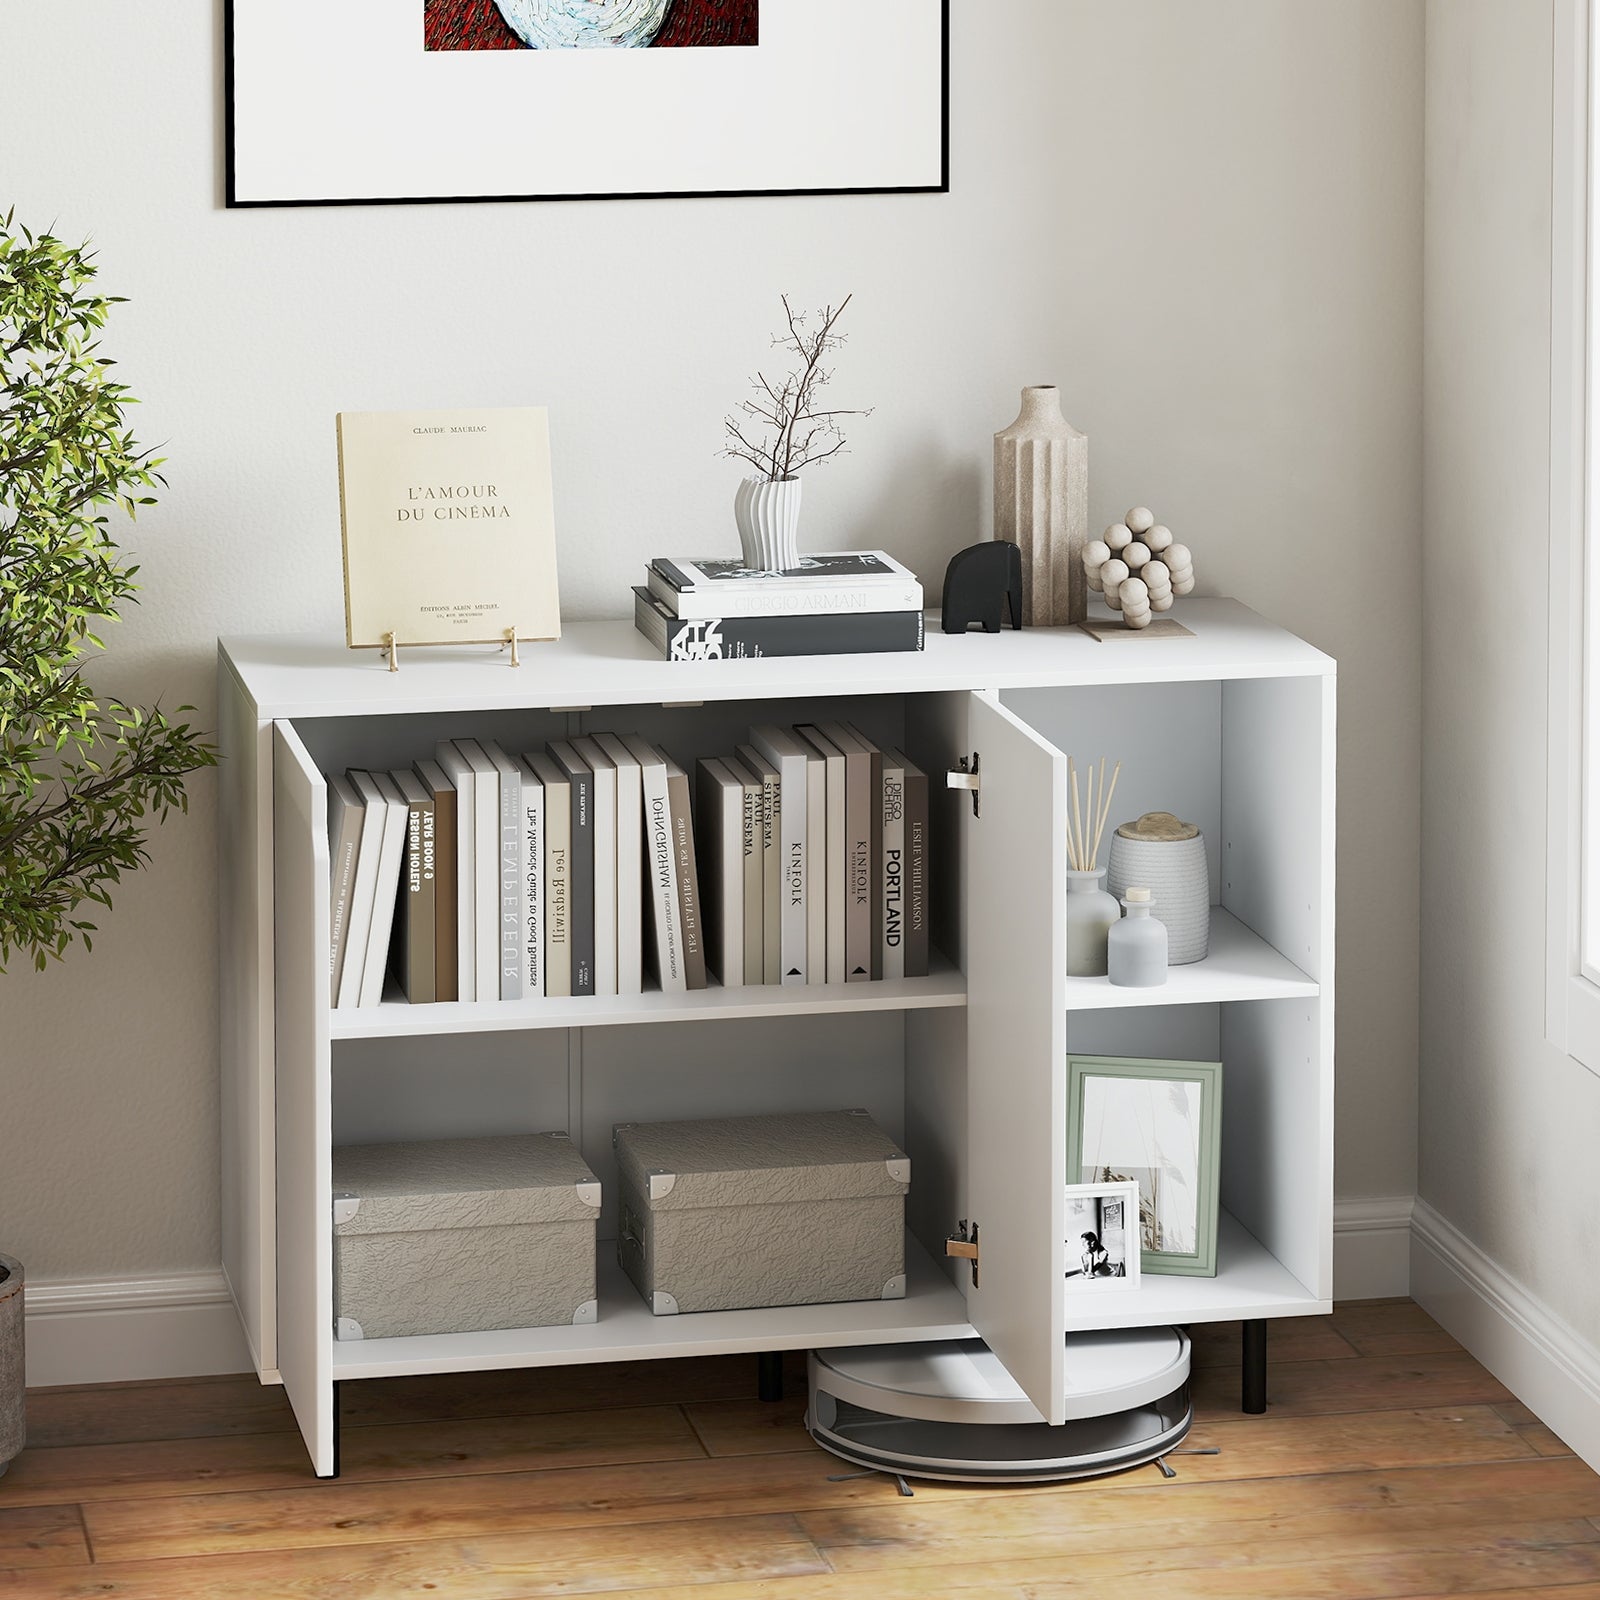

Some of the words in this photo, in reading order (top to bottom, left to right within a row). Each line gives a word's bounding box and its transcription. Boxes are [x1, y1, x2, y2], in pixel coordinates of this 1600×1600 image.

[450, 425, 487, 433] MAURIAC
[409, 485, 497, 500] L'AMOUR
[398, 508, 424, 521] DU
[434, 505, 510, 520] CINÉMA
[734, 594, 798, 610] GIORGIO
[802, 592, 867, 609] ARMANI
[884, 777, 893, 827] UCHITEL
[893, 783, 902, 820] DIEGO
[912, 822, 921, 855] LESLIE
[792, 843, 802, 906] KINFOLK
[856, 841, 867, 904] KINFOLK
[886, 850, 900, 947] PORTLAND
